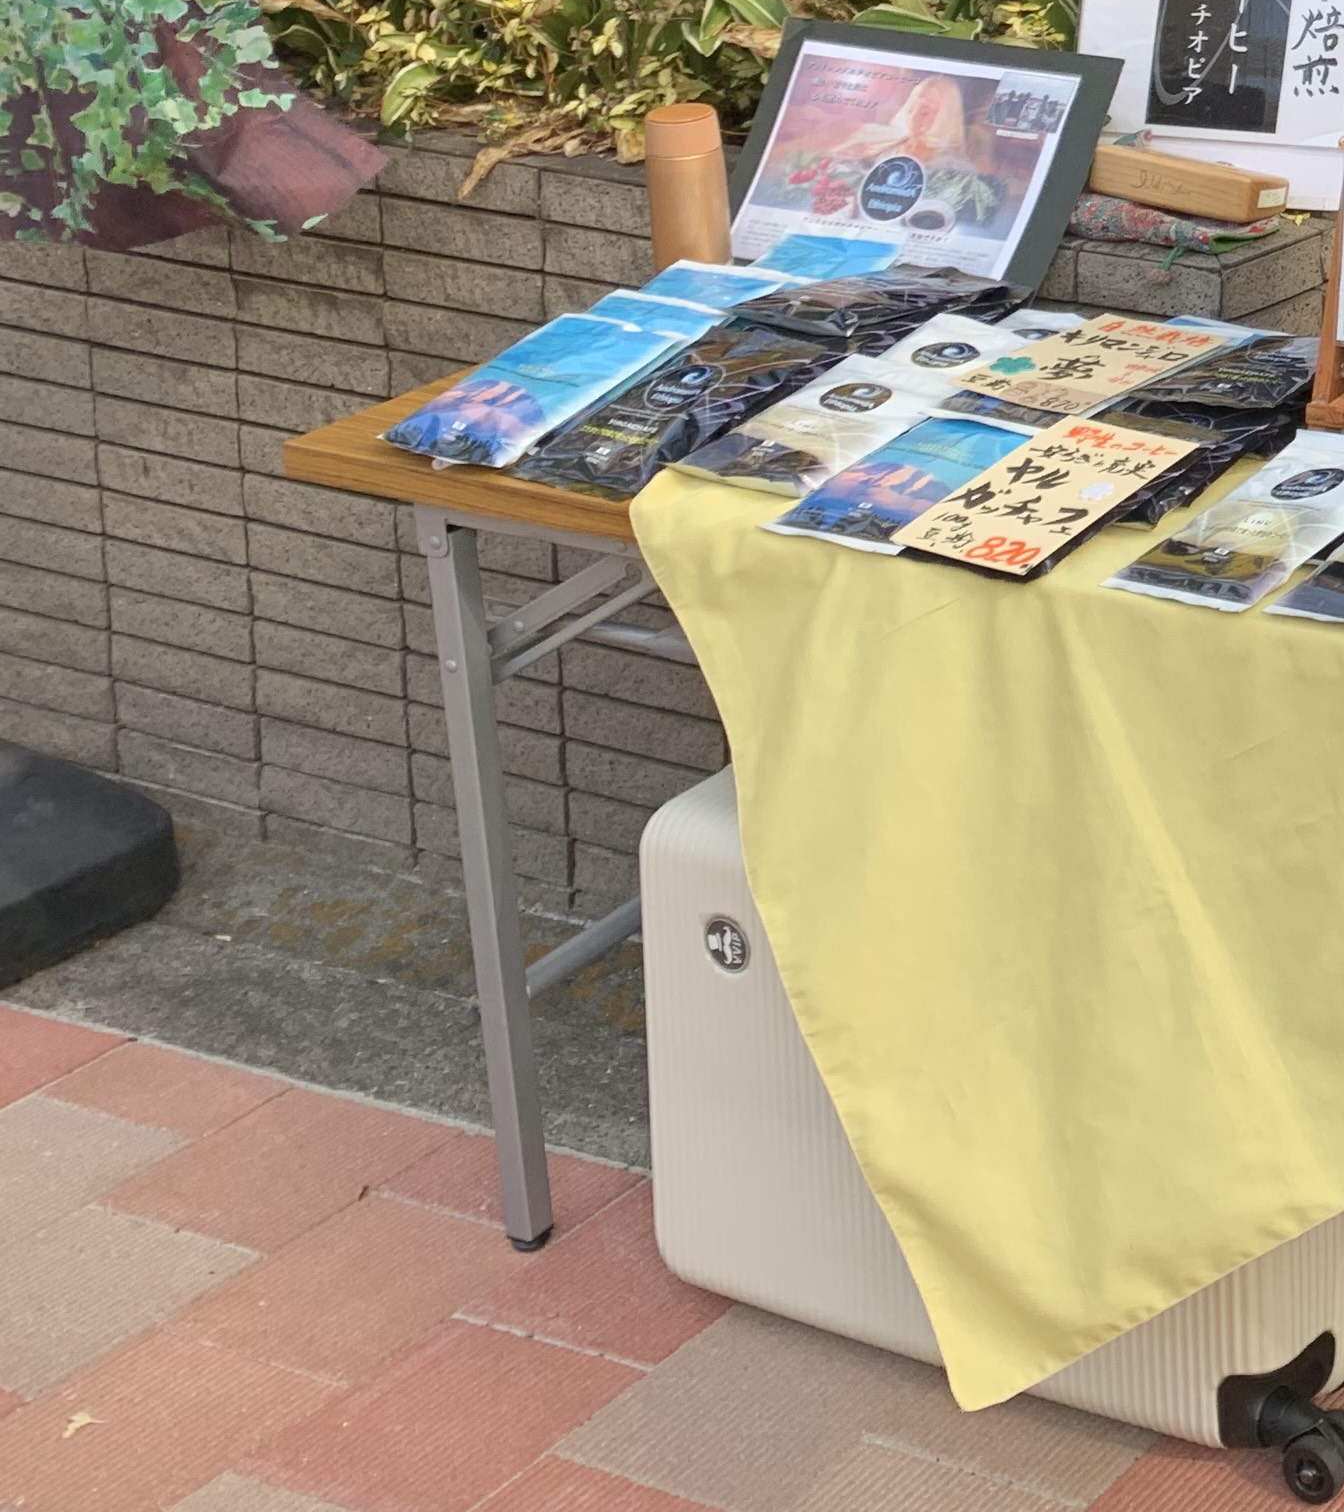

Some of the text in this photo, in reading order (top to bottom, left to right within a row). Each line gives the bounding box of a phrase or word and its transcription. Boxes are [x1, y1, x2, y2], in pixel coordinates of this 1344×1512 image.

[1062, 425, 1180, 457] 野生のコーヒー
[1005, 457, 1072, 491] ヤル
